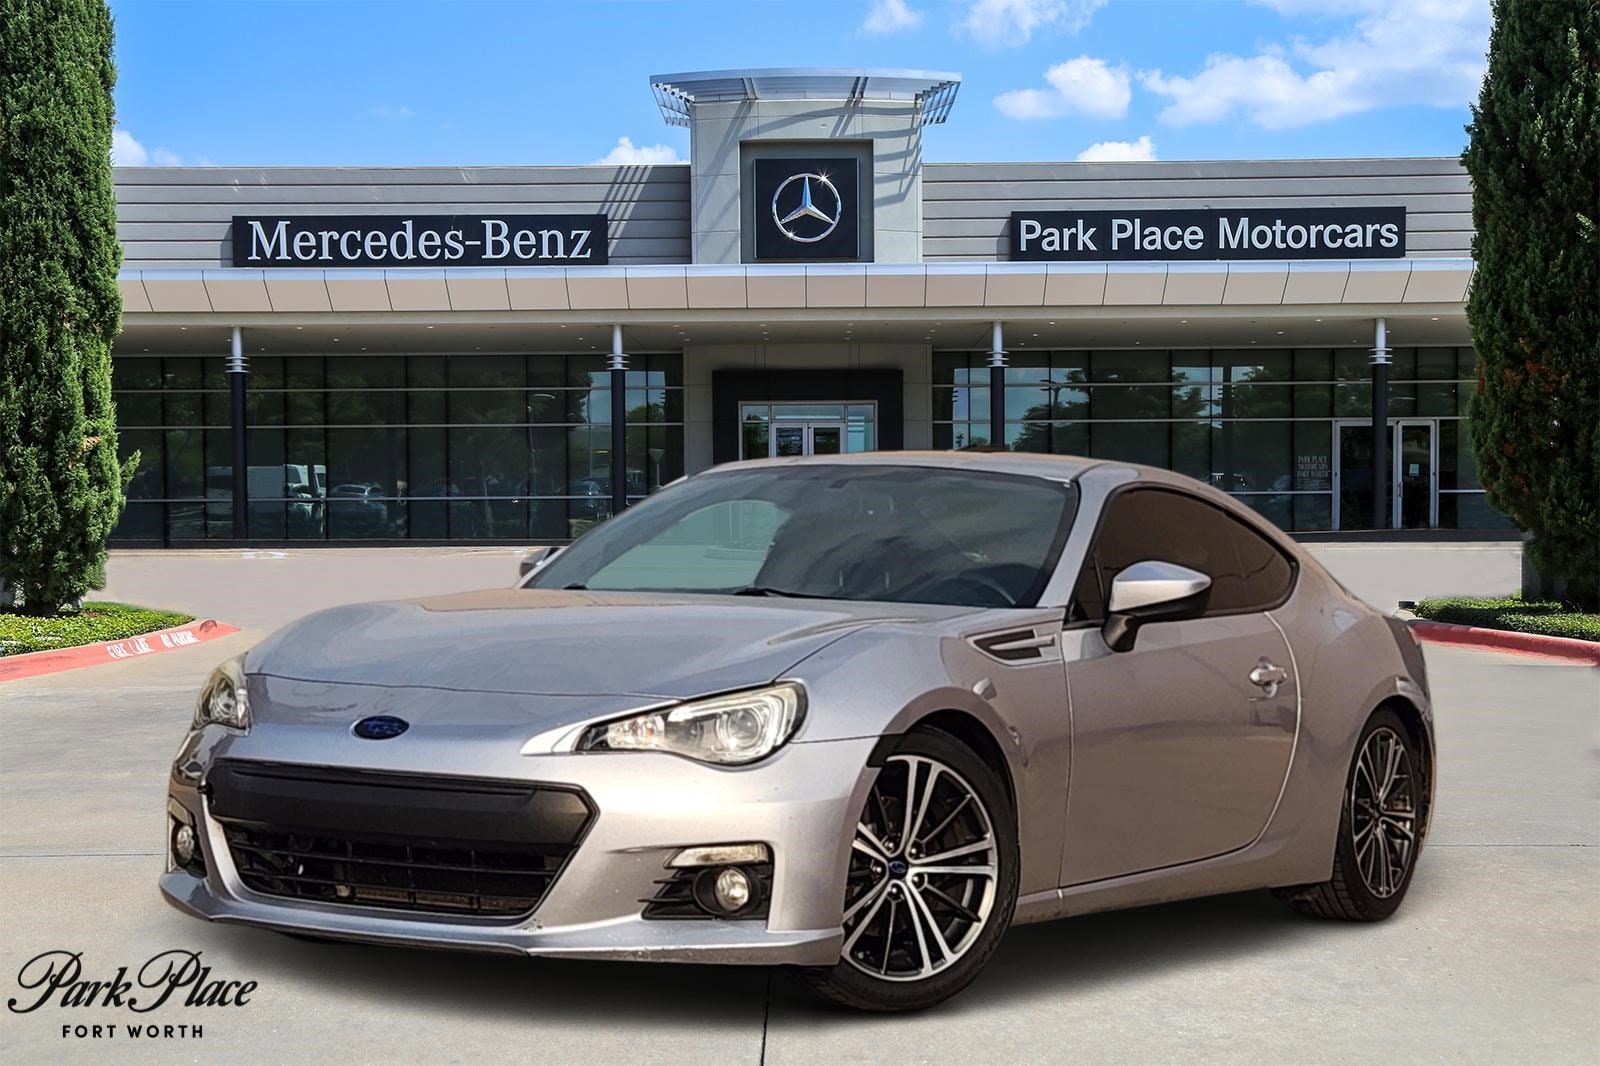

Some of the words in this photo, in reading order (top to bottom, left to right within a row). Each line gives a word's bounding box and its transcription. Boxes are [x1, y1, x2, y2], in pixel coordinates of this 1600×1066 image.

[248, 219, 592, 260] Mercedes-Benz
[1020, 219, 1097, 251] Park
[1111, 219, 1204, 250] Place
[1219, 217, 1400, 249] Motorcars
